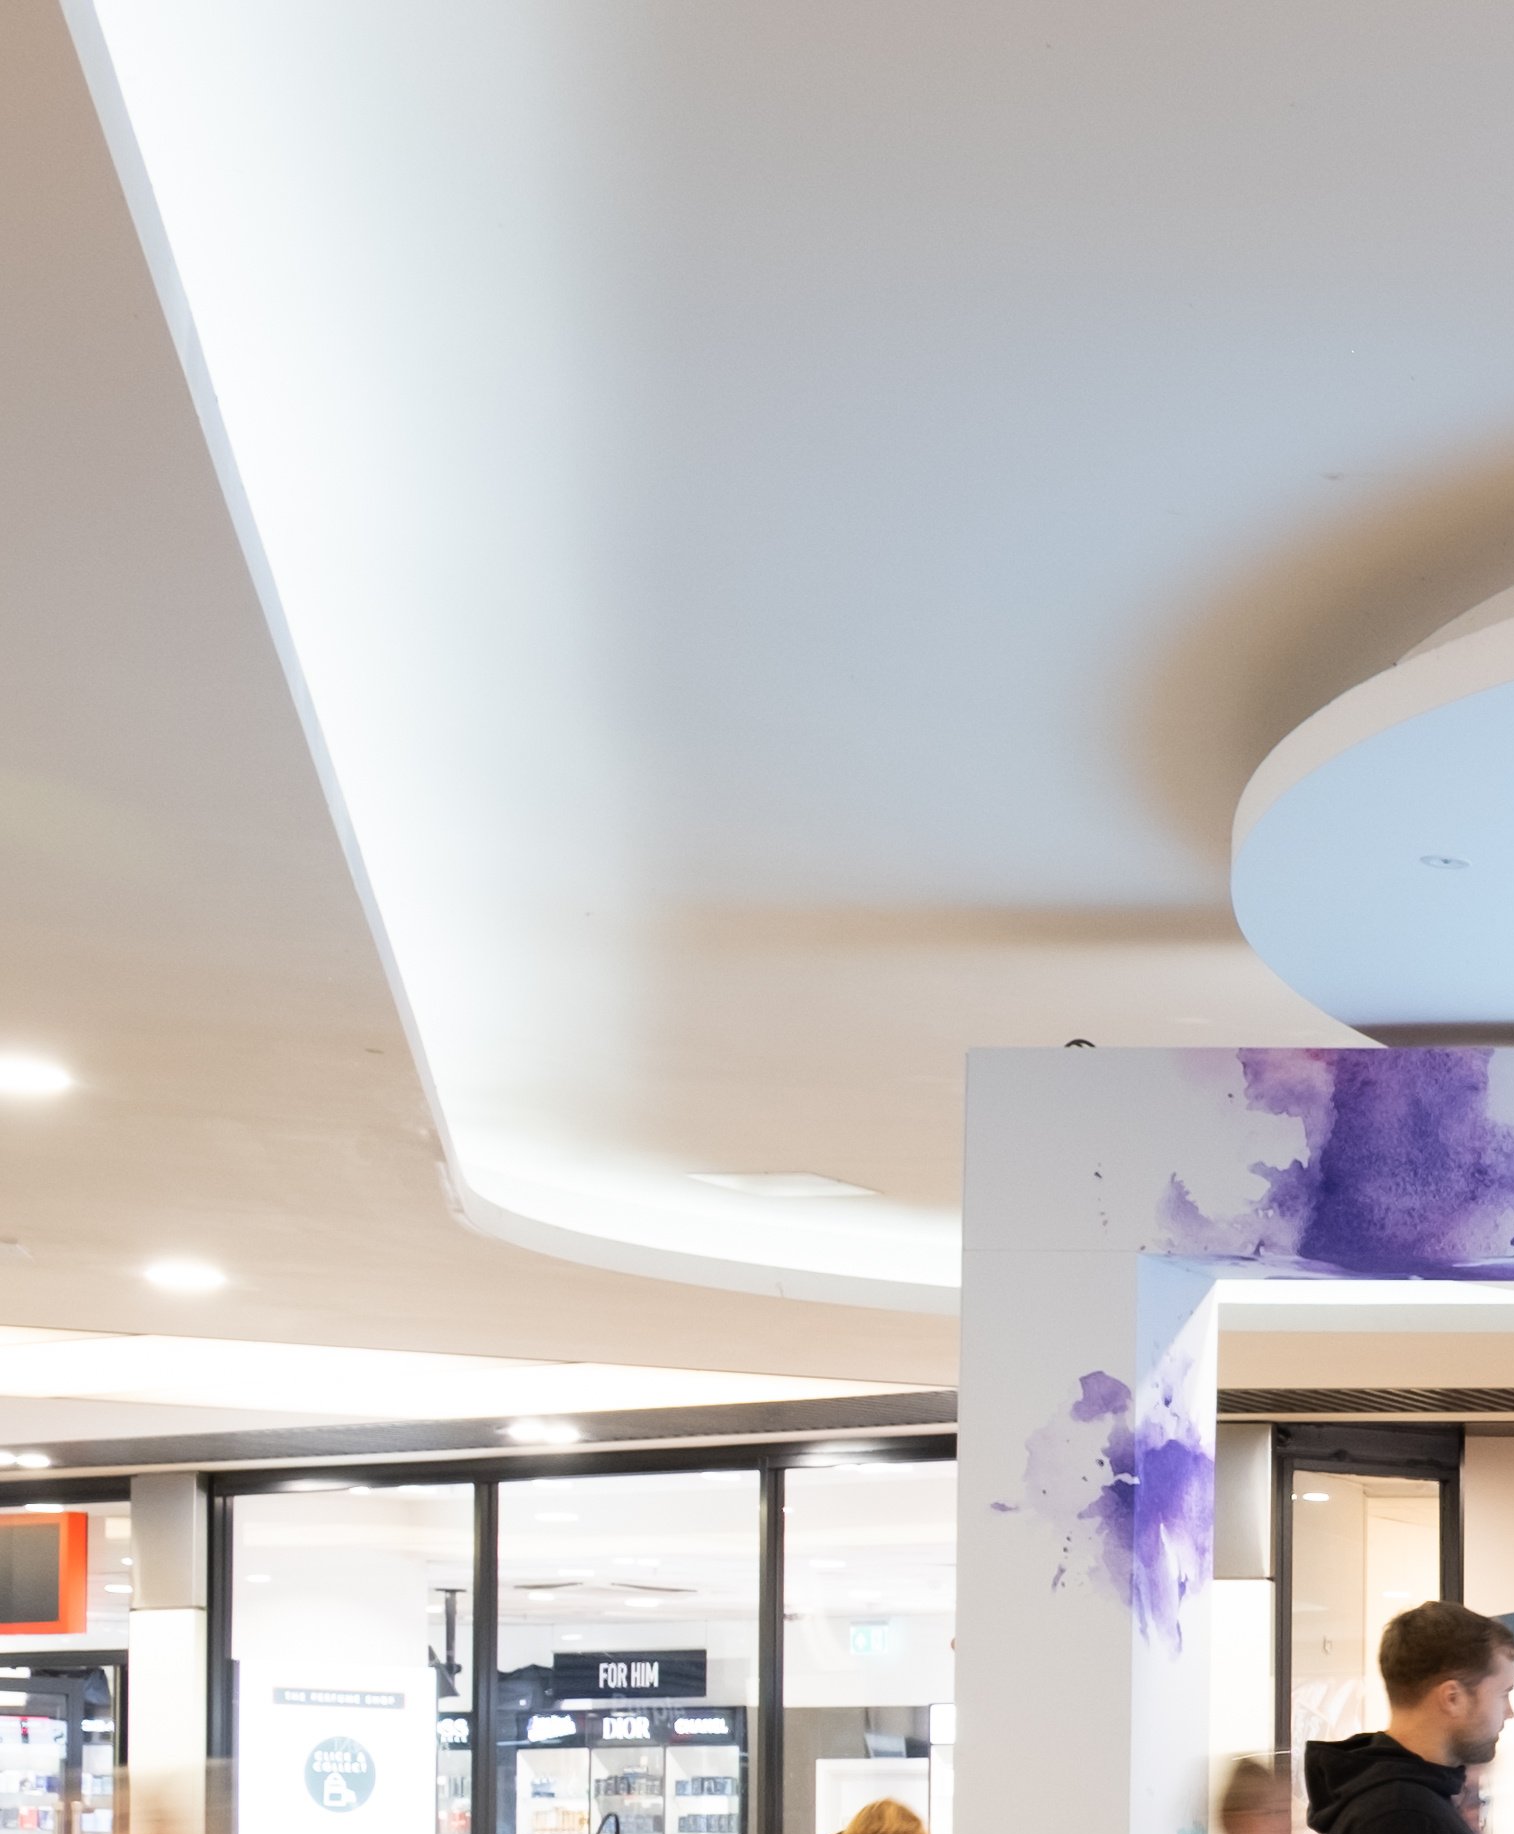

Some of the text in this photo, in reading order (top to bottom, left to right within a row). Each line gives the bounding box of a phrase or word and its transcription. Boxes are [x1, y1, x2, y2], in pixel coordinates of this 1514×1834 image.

[599, 1662, 658, 1688] FOR HIM
[602, 1715, 650, 1740] DIOR
